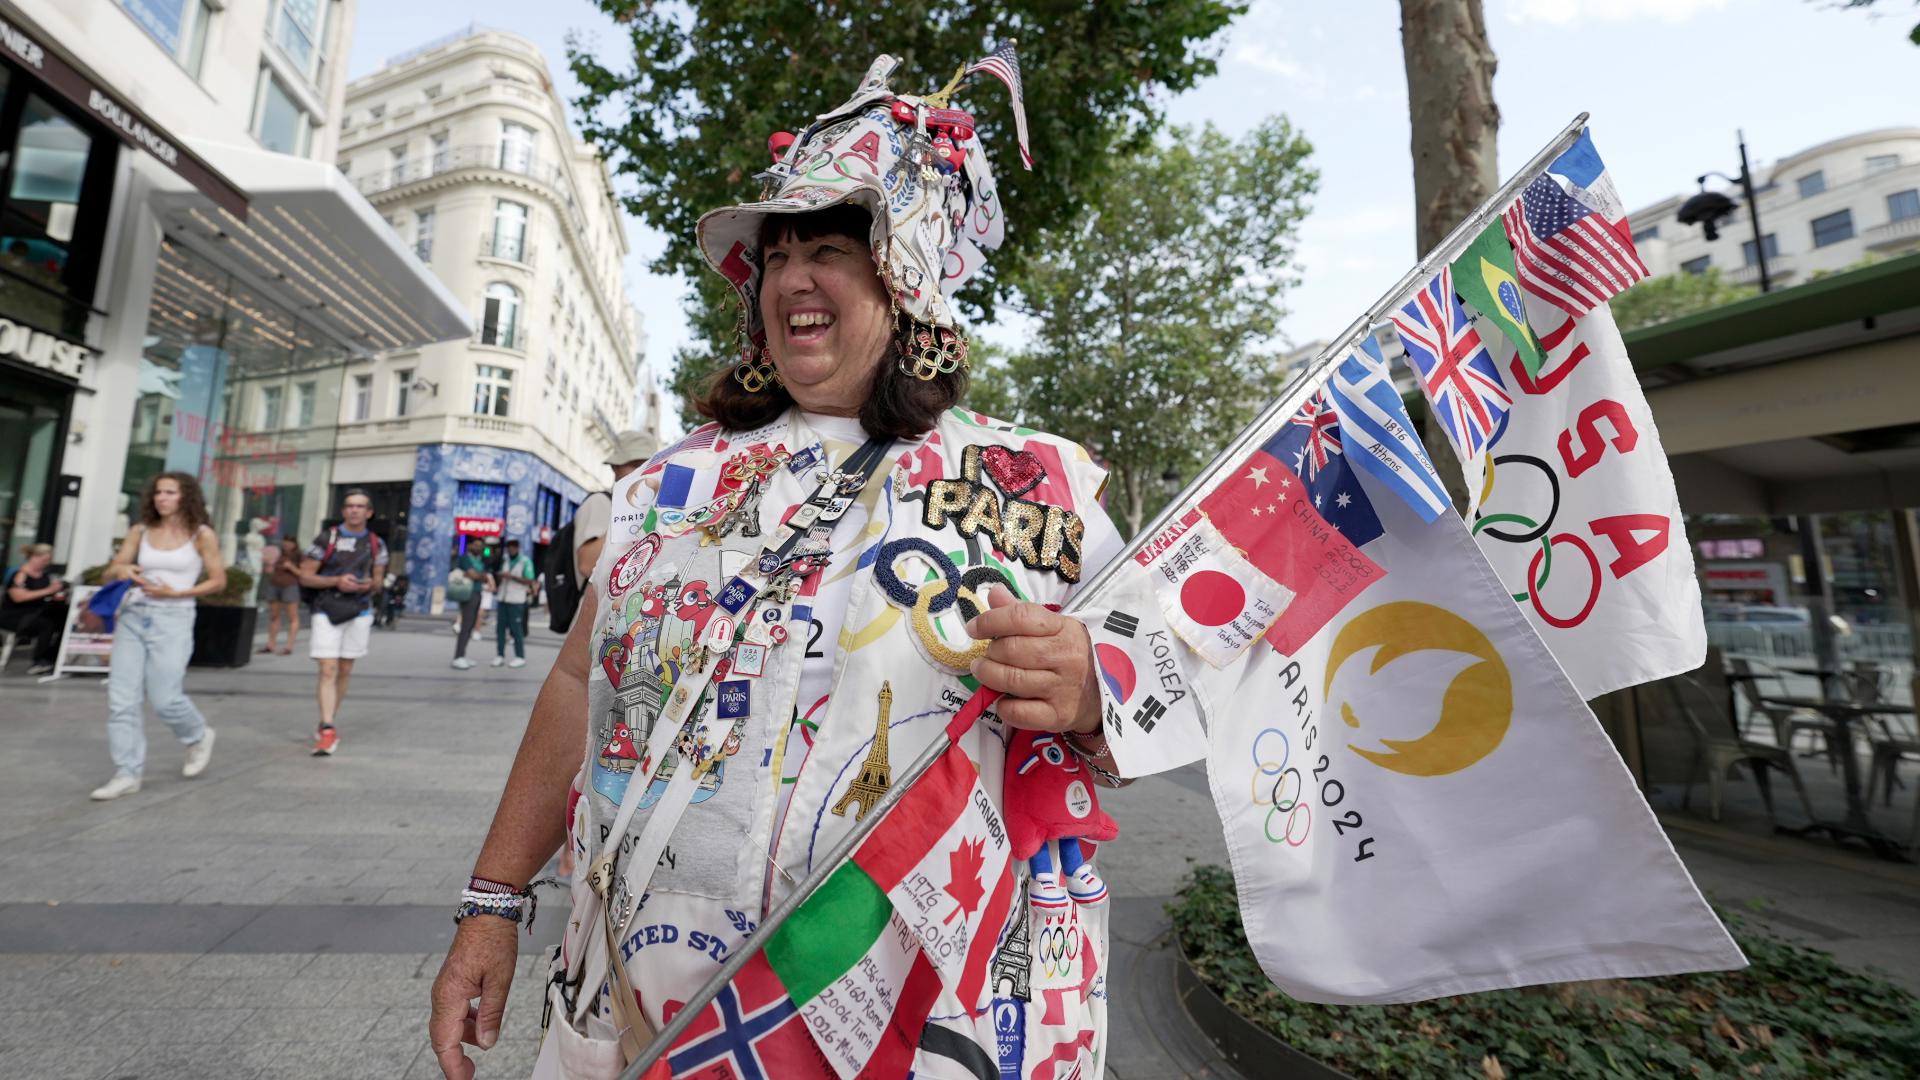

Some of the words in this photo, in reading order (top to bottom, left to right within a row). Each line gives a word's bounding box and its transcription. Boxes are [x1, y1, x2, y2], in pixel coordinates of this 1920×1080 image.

[1383, 418, 1408, 441] 1896
[1367, 443, 1402, 473] Athens
[613, 513, 645, 523] PARIS
[923, 479, 1085, 584] PARIS
[1143, 520, 1189, 563] JAPAN
[1180, 542, 1199, 566] 1972
[1188, 533, 1211, 557] 1964
[1293, 499, 1330, 545] CHINA
[1334, 544, 1374, 578] 2008
[1159, 561, 1179, 584] 2020
[726, 584, 747, 603] PARIS
[1253, 598, 1275, 619] Tokyo
[1145, 630, 1186, 706] KOREA
[722, 691, 747, 703] PARIS
[942, 690, 967, 710] Olymp
[974, 789, 1006, 851] CANADA
[1312, 754, 1376, 863] 2024
[908, 872, 942, 907] 1976
[620, 924, 679, 963] ITED
[891, 911, 916, 955] ITALY
[913, 916, 952, 958] 2010
